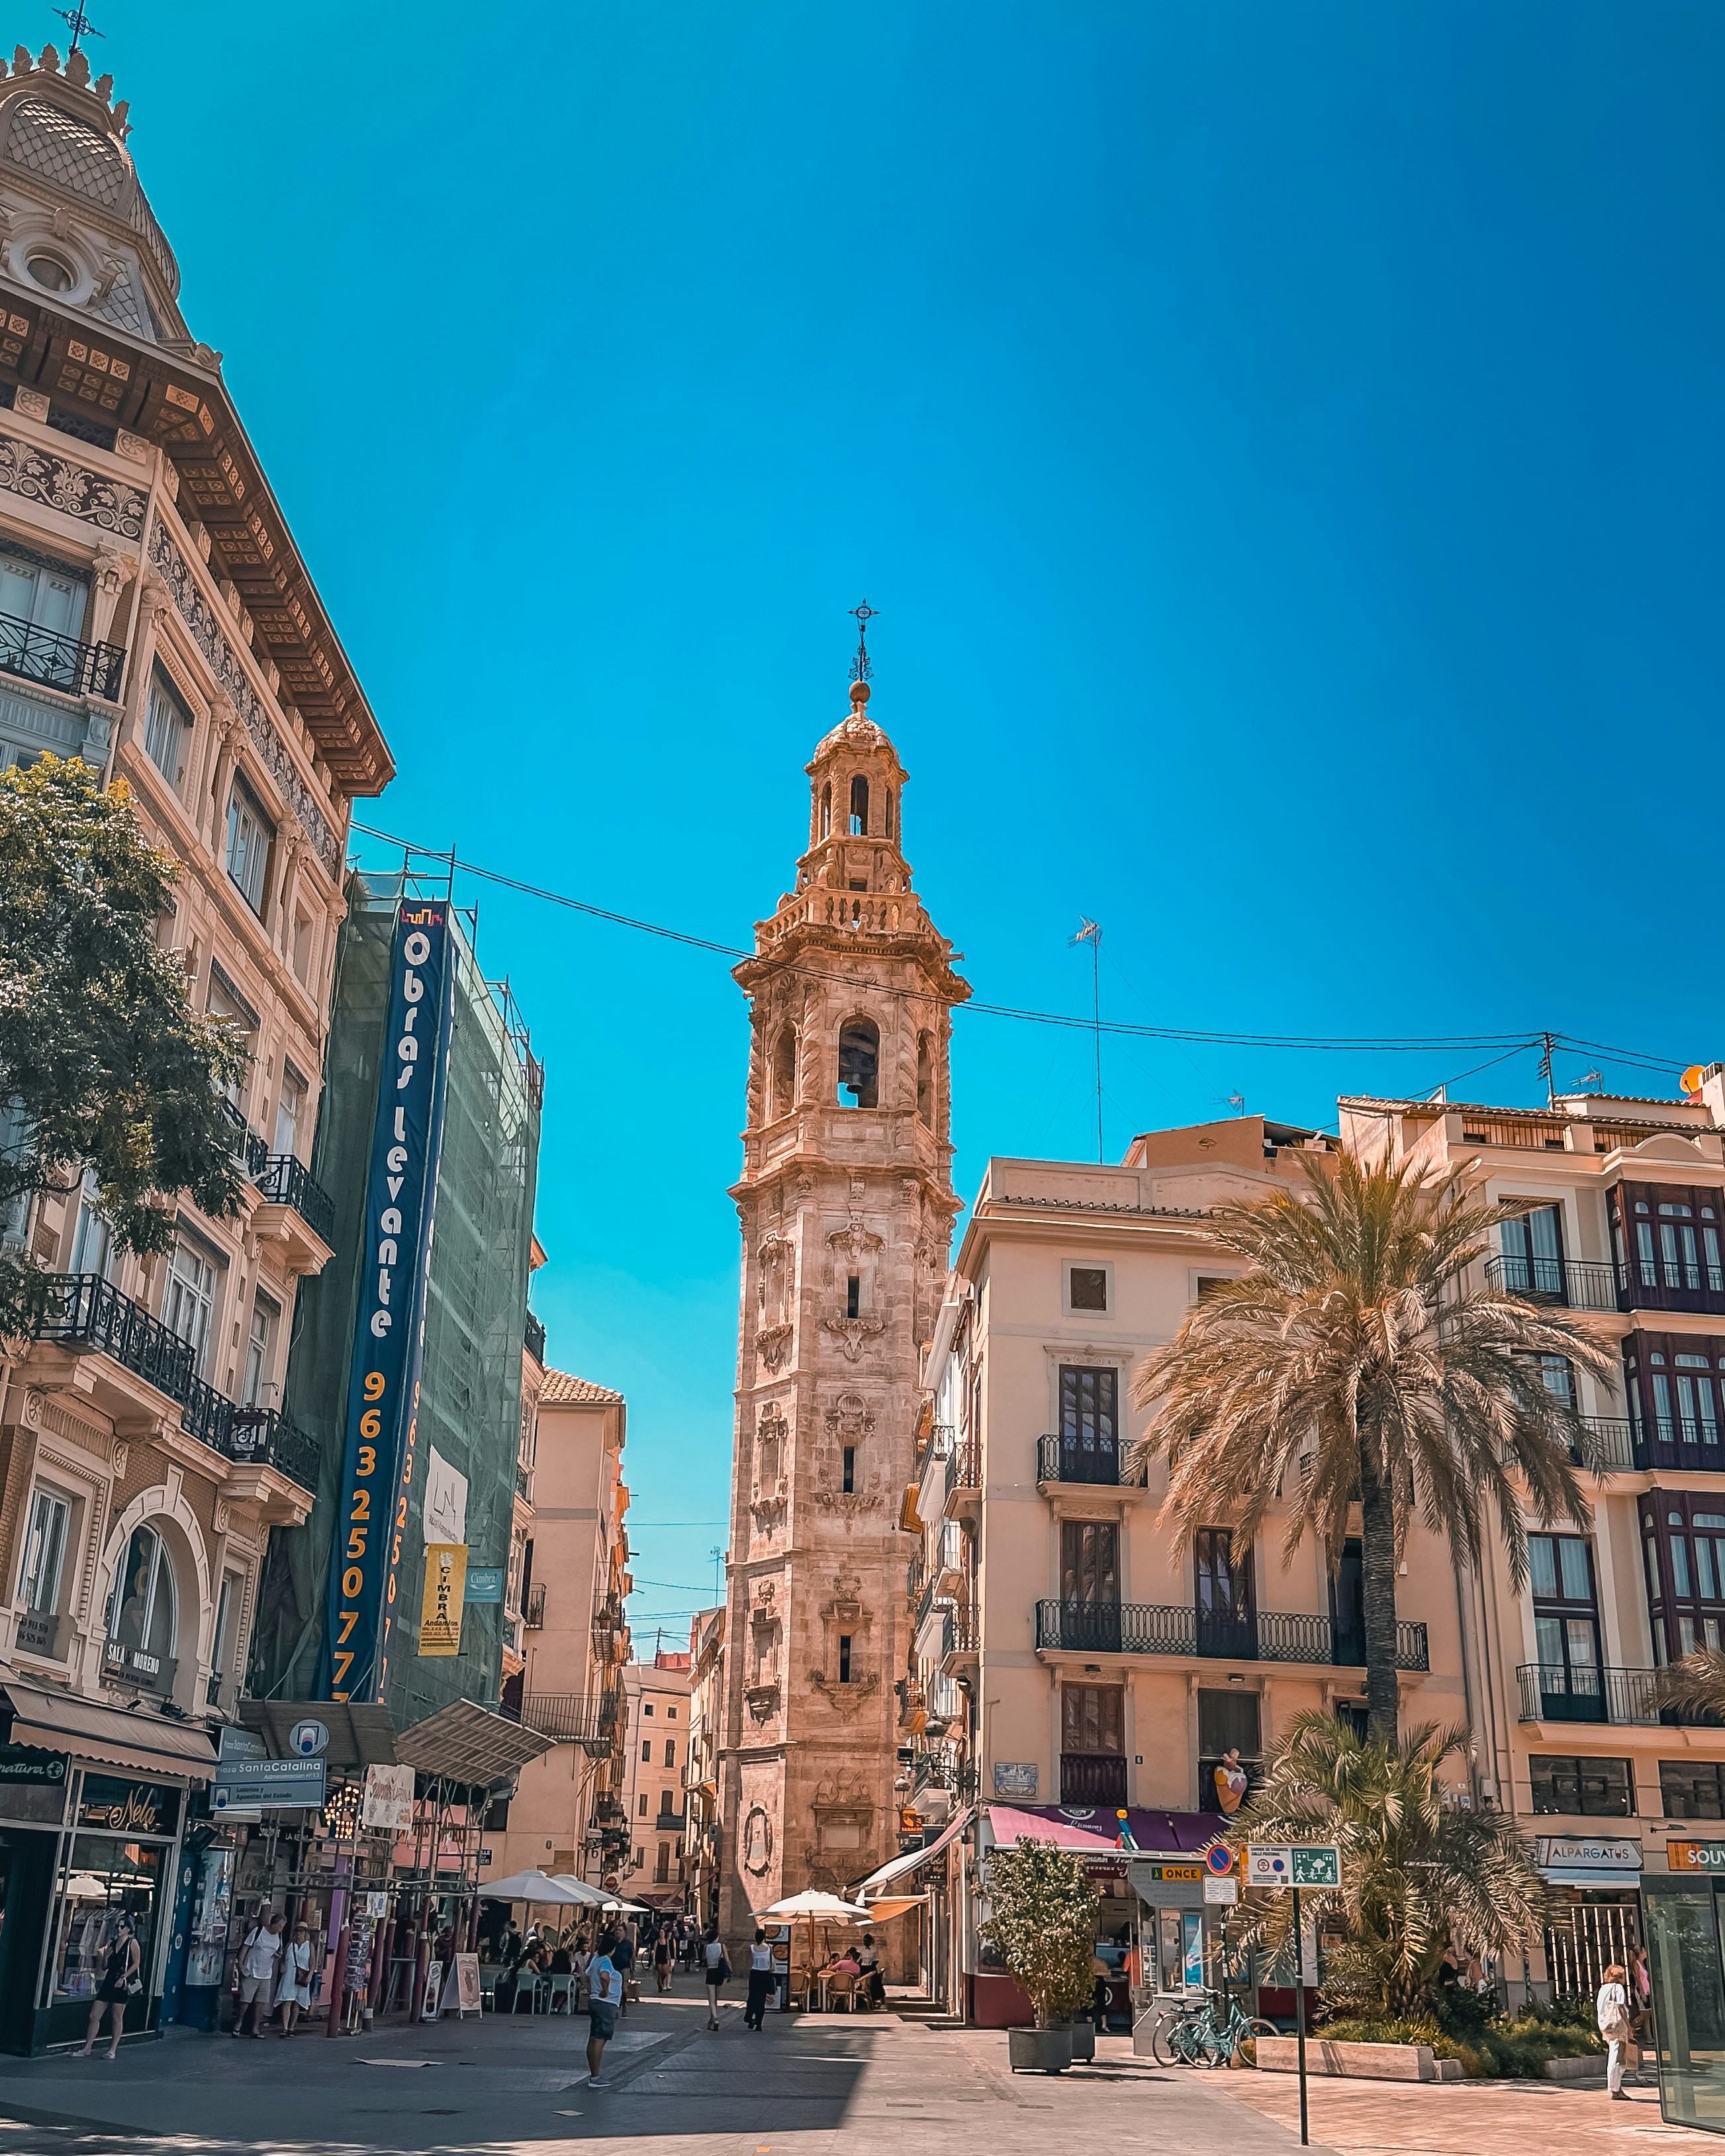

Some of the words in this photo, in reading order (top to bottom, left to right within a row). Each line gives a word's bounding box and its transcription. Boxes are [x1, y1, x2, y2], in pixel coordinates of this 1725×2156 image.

[396, 931, 430, 1089] Obras
[357, 1371, 385, 1477] 963
[342, 1489, 371, 1599] 250
[436, 1566, 451, 1620] CIMBRA
[107, 1643, 125, 1664] SALA
[132, 1652, 160, 1675] MORENO
[238, 1761, 321, 1773] SantaCatalina
[109, 1785, 156, 1829] Nela
[1166, 1869, 1197, 1879] ONCE
